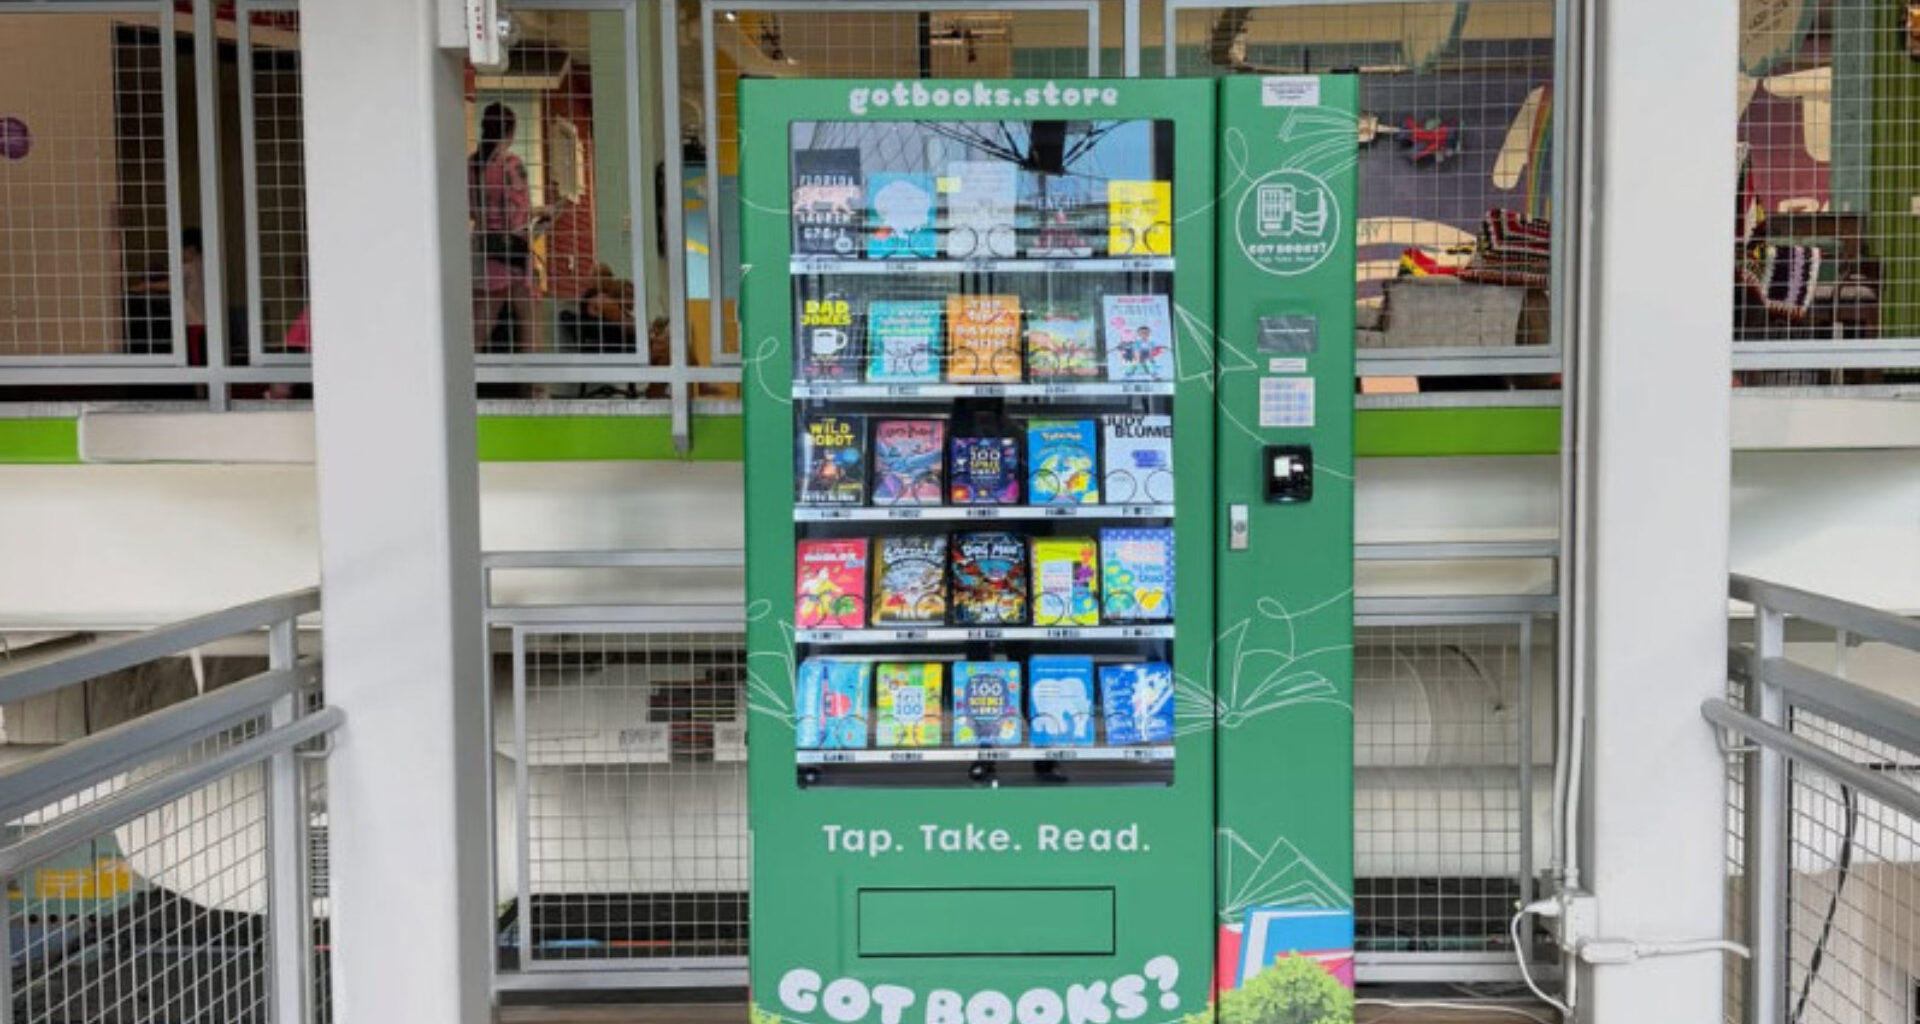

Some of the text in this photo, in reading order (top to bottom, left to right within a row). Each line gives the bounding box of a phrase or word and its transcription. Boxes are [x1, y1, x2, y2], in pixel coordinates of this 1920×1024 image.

[849, 81, 1118, 114] gotbooks.store
[805, 300, 849, 314] DAD
[809, 423, 850, 433] WILD
[1115, 426, 1173, 438] BLUME
[970, 682, 1003, 696] 100
[823, 823, 1151, 858] Tap. Take. Read.
[778, 955, 1180, 1024] GOT BOOKS?
